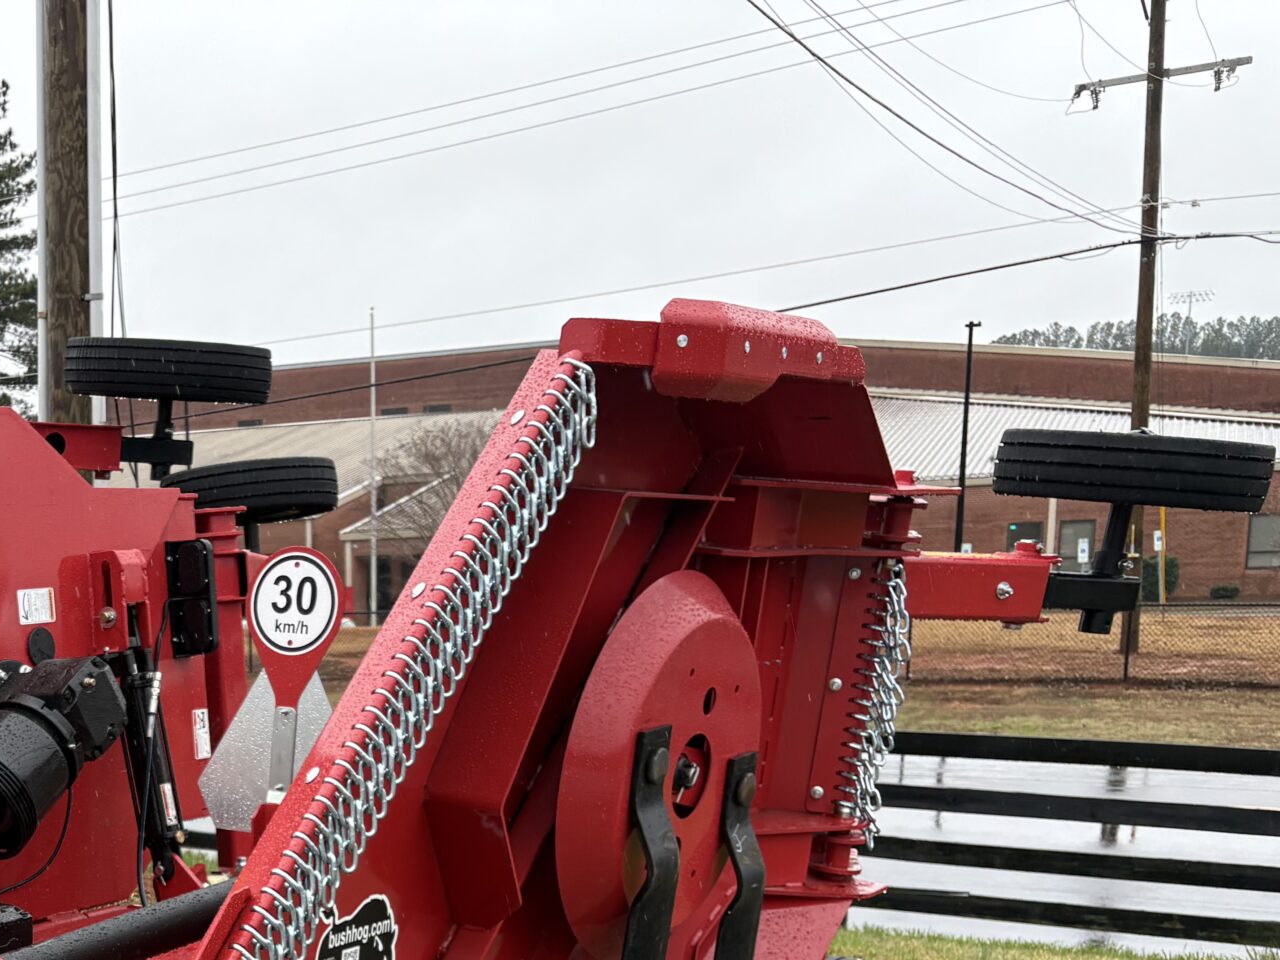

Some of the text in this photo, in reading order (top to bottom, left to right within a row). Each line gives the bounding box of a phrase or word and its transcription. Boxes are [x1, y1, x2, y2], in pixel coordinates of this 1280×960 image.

[271, 574, 318, 616] 30
[274, 619, 309, 635] km/h
[328, 919, 392, 949] bushhog.com
